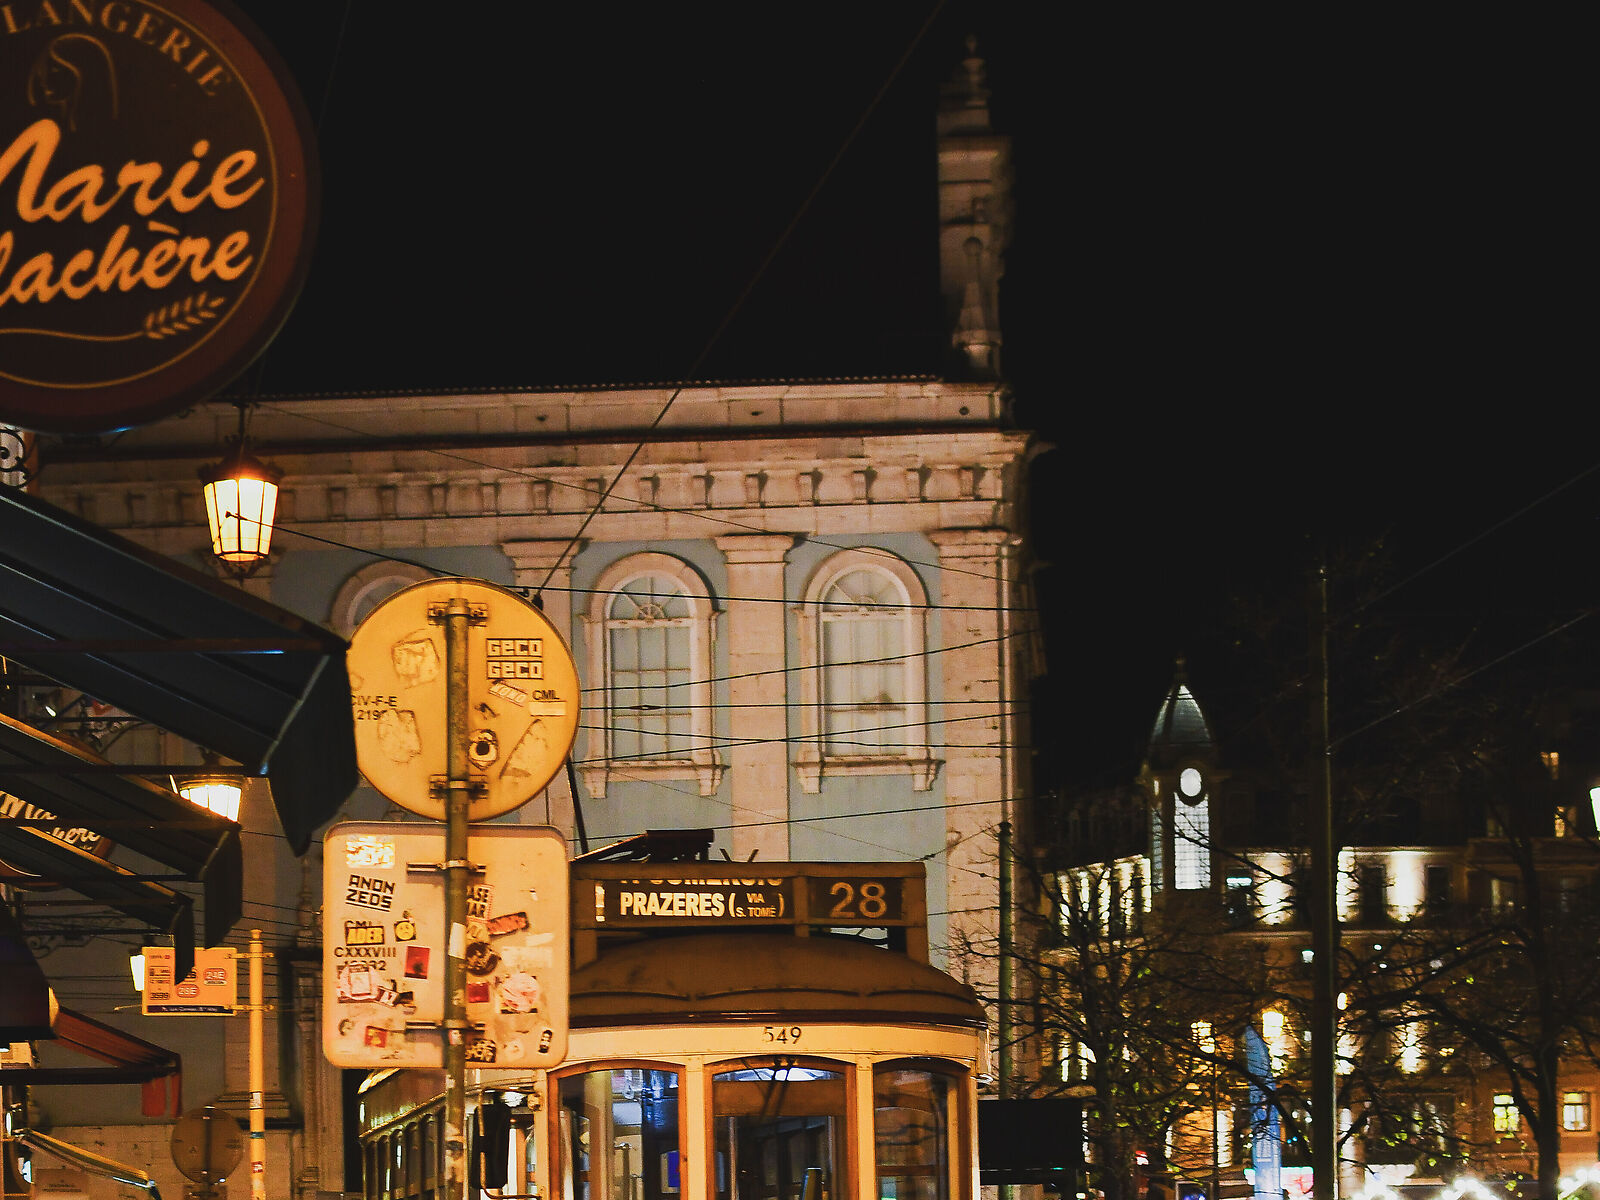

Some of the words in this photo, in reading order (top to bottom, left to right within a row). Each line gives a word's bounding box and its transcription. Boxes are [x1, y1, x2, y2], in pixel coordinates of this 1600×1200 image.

[619, 891, 726, 917] PRAZERES
[829, 881, 887, 919] 28
[334, 947, 397, 958] CXXXVIII
[761, 1026, 802, 1045] 549
